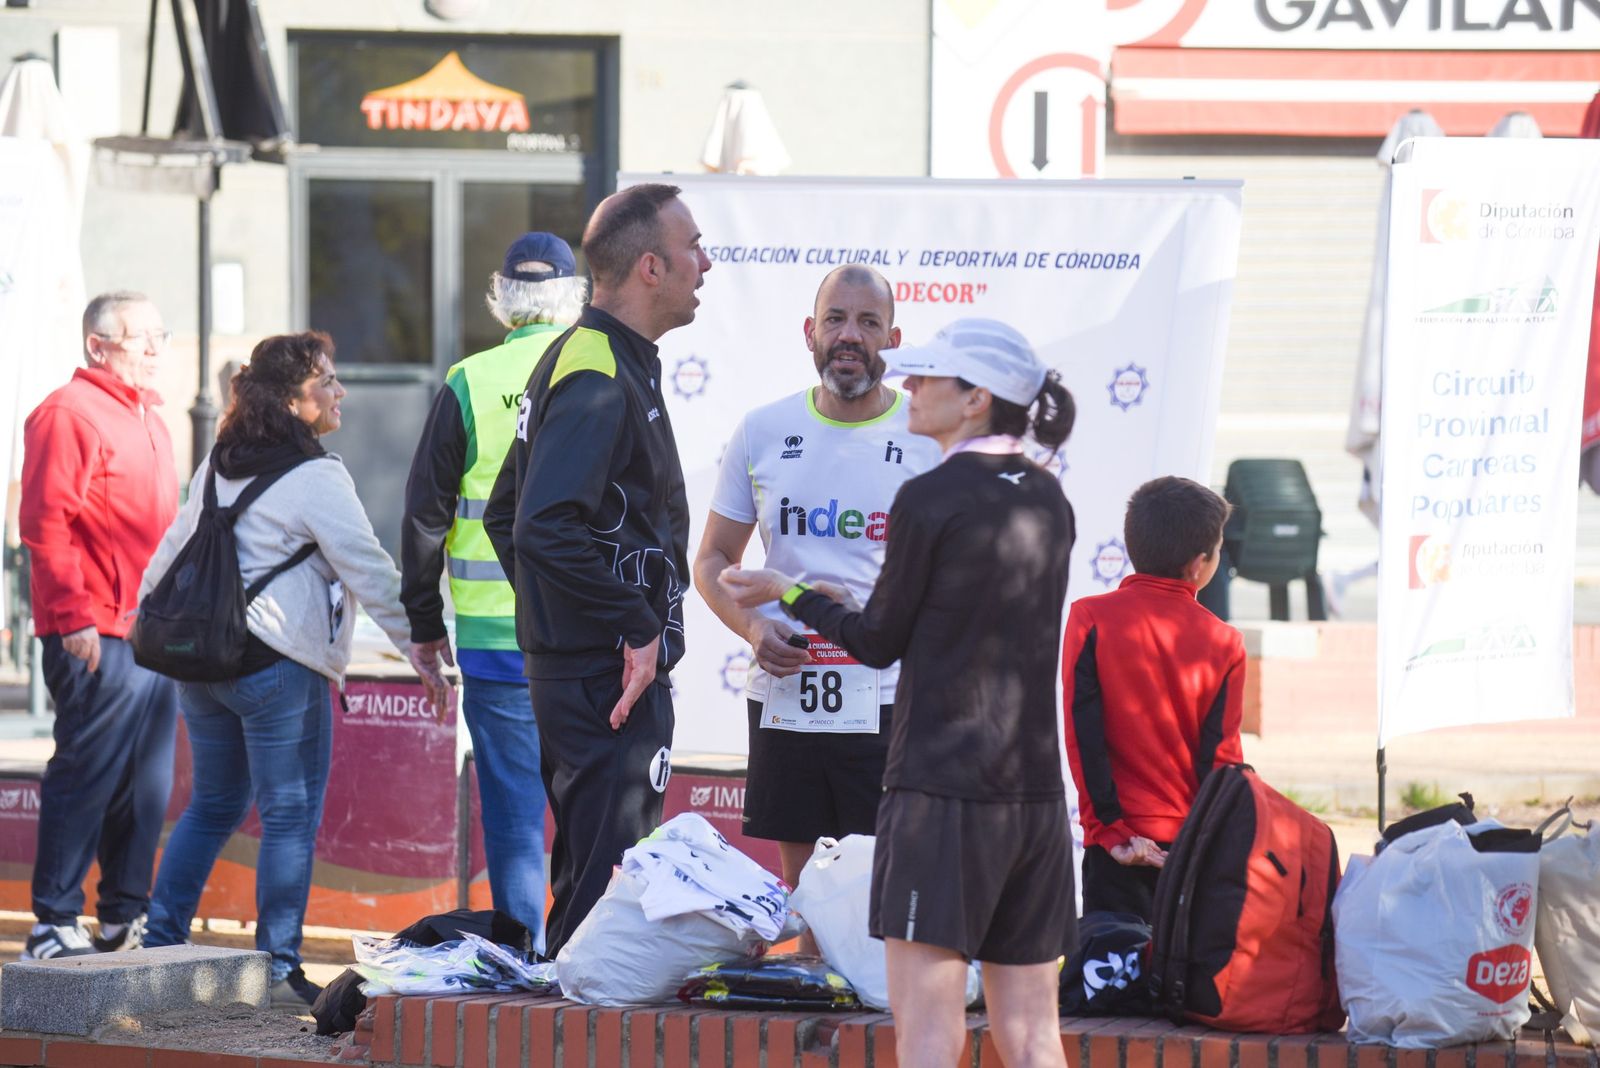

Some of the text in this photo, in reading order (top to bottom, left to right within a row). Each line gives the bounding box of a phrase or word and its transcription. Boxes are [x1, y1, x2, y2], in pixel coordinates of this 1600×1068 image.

[361, 96, 530, 131] TINDAYA
[1479, 202, 1574, 220] Diputación
[708, 246, 800, 263] SOCIACIÓN
[805, 248, 890, 265] CULTURAL
[898, 250, 909, 265] Y
[919, 250, 1017, 267] DEPORTIVA
[1024, 252, 1050, 268] DE
[884, 440, 903, 464] in
[780, 497, 891, 541] indea
[816, 650, 849, 658] CULDECOR
[800, 670, 843, 713] 58
[1475, 959, 1528, 986] Deza
